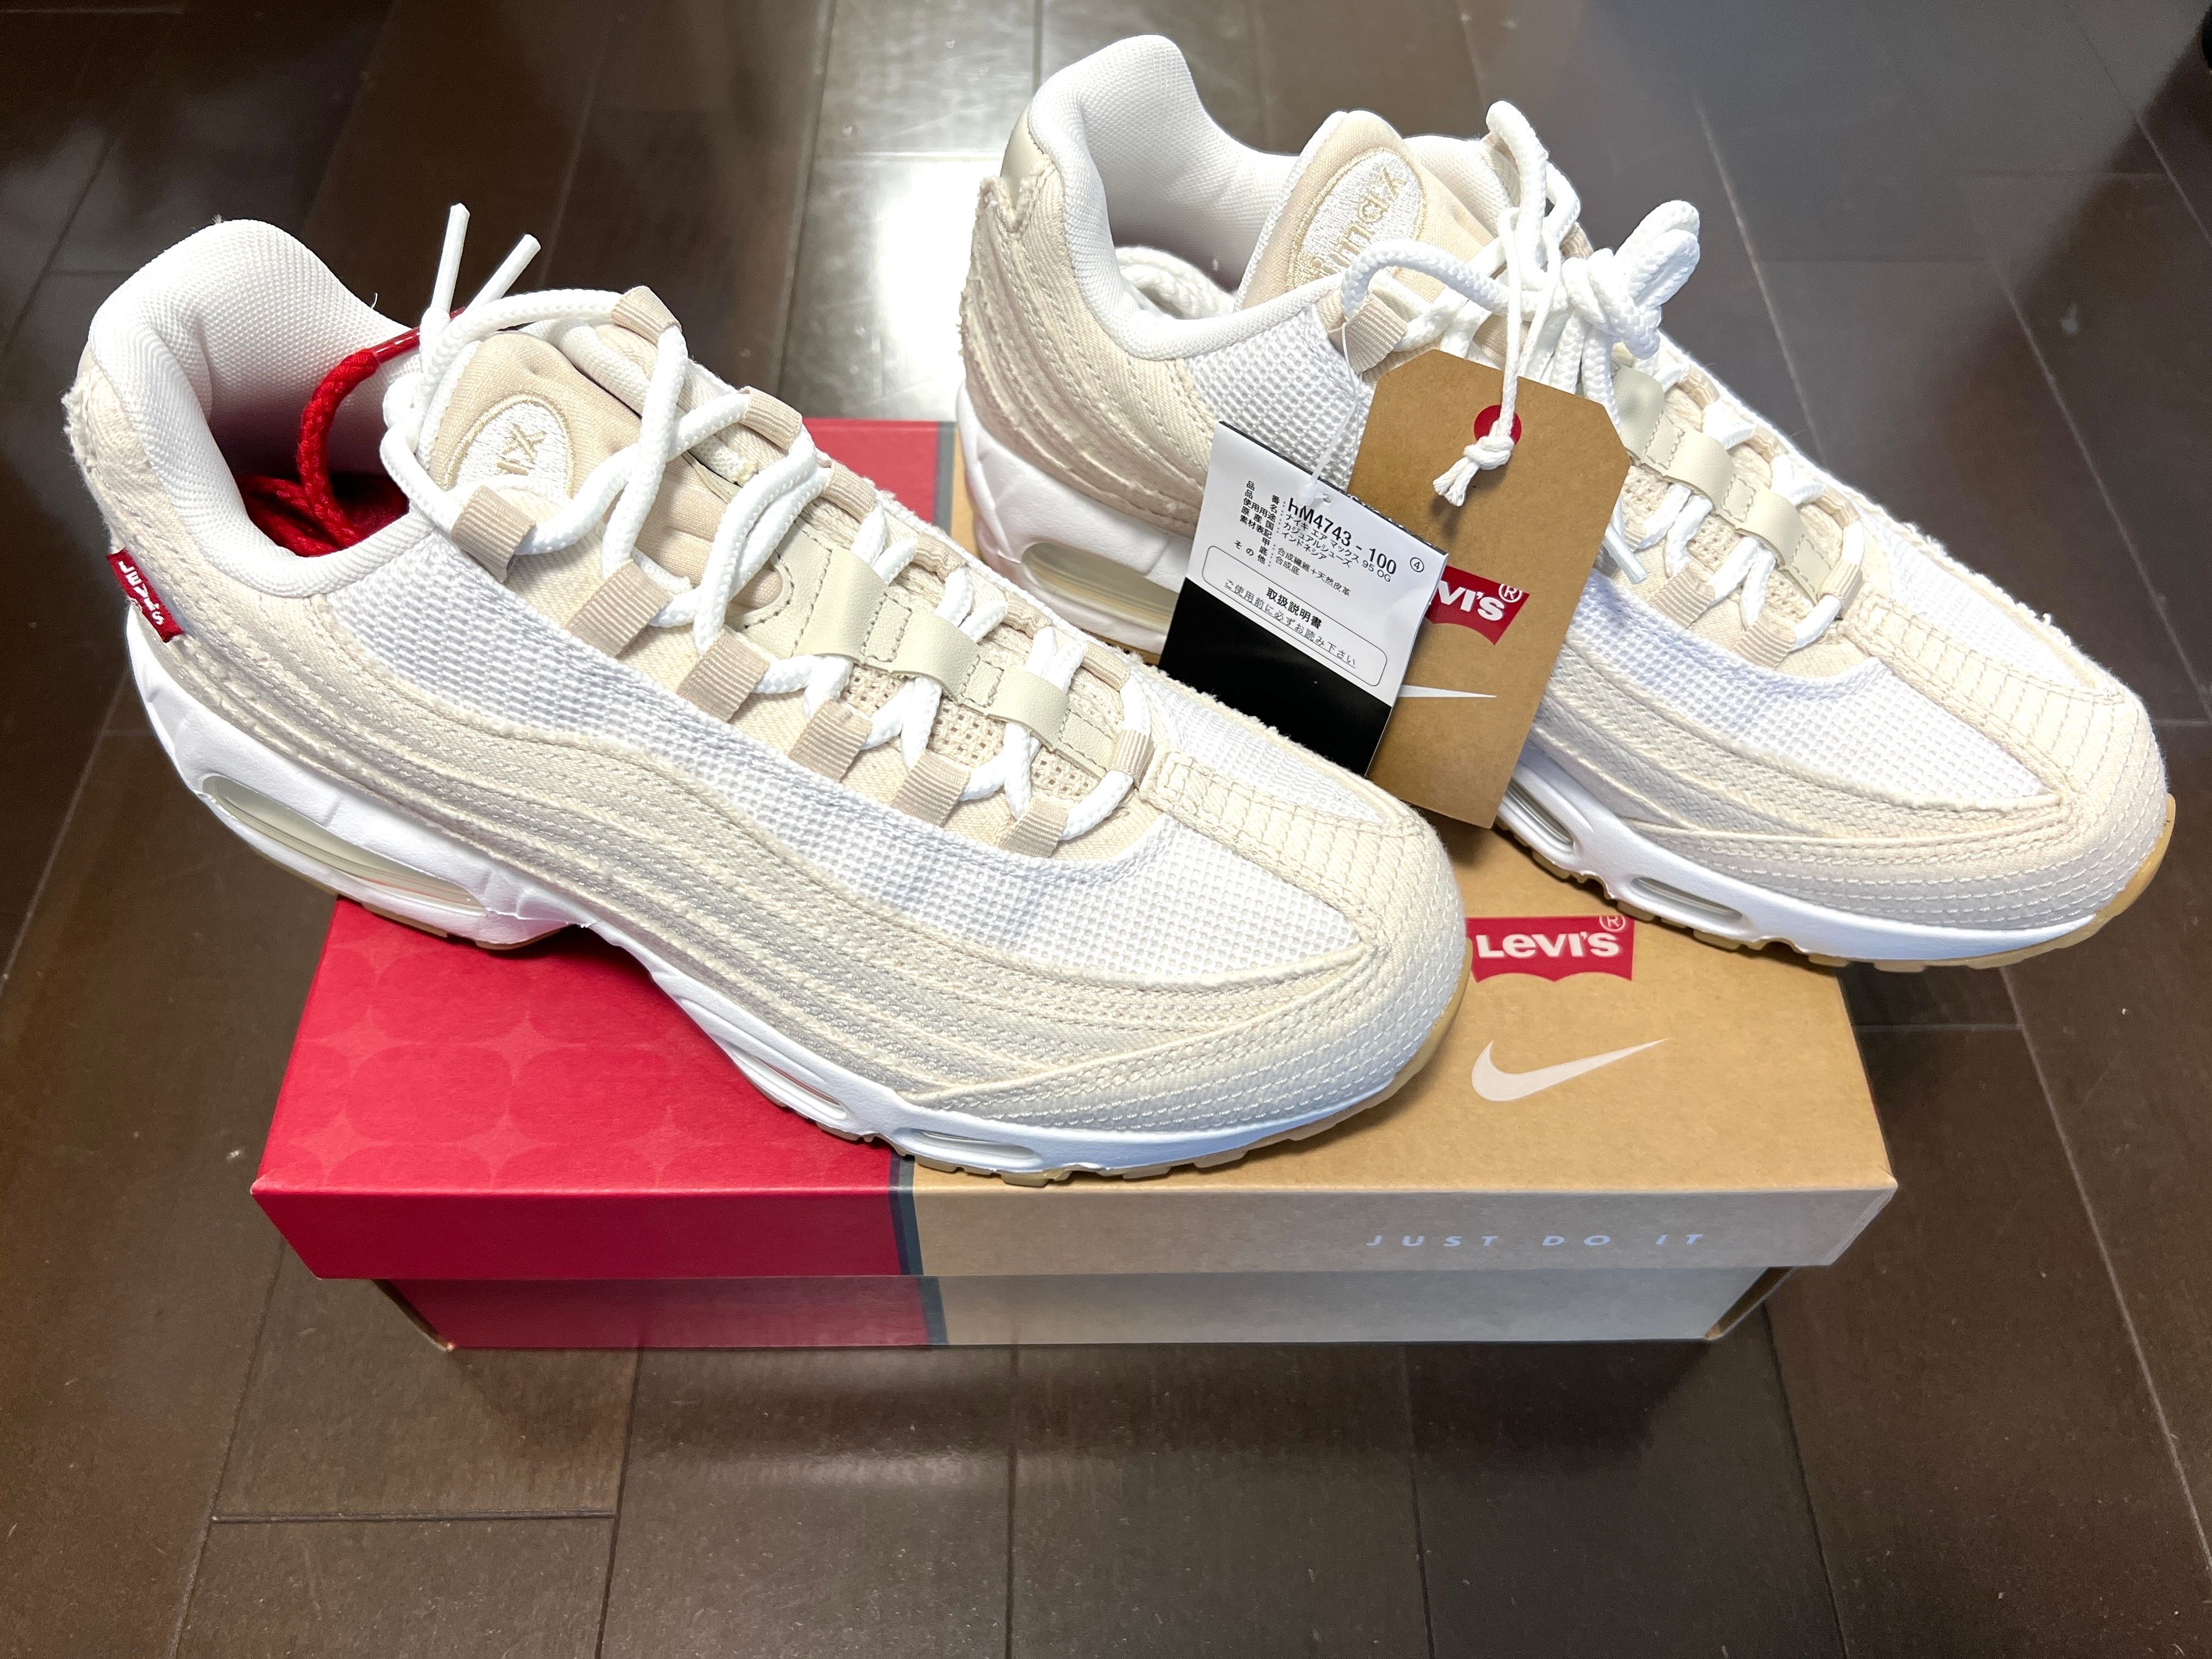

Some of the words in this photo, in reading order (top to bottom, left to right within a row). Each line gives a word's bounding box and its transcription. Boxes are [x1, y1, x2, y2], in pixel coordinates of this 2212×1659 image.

[1281, 532, 1327, 559] インドネシア
[1286, 514, 1308, 530] ナイキ
[1310, 529, 1327, 540] エア
[1330, 539, 1359, 563] マックス
[1362, 560, 1374, 572] 95
[1377, 569, 1391, 582] OG
[1369, 548, 1396, 574] 100
[1266, 587, 1322, 629] 取扱説明書
[1366, 1235, 1498, 1247] JUST
[1542, 1235, 1611, 1247] DO
[1656, 1234, 1704, 1245] IT
